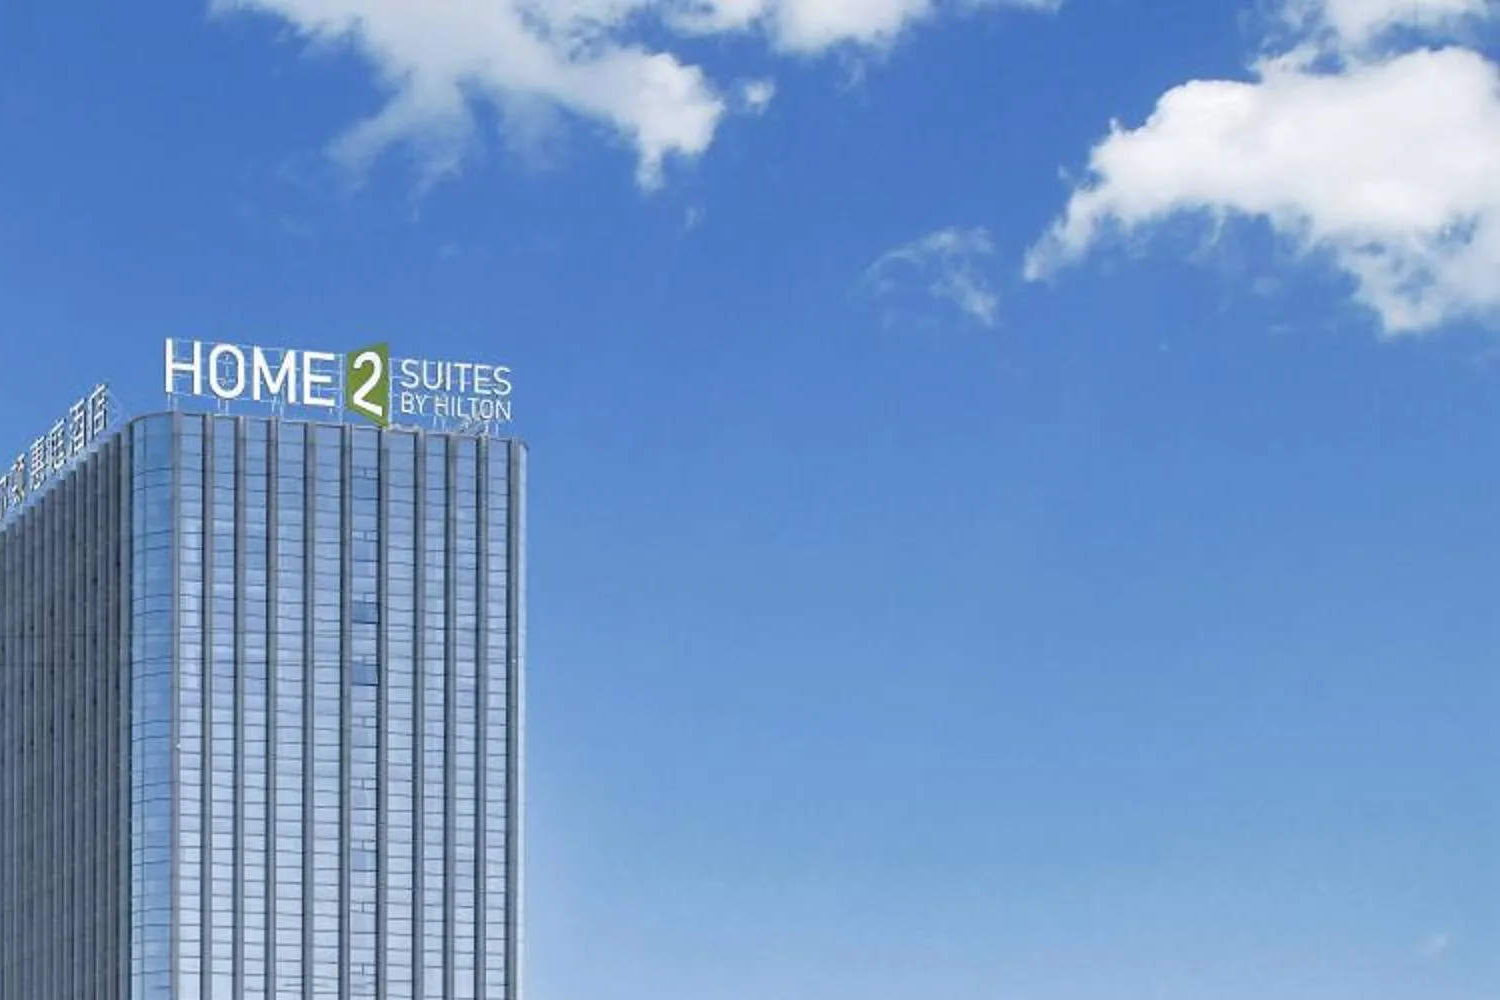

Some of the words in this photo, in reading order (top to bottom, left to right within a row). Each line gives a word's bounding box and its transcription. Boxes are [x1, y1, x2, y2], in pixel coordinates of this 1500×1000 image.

[164, 337, 335, 407] HOME
[352, 351, 383, 417] 2
[400, 359, 512, 396] SUITES
[401, 391, 432, 416] BY
[435, 395, 512, 421] HILTON
